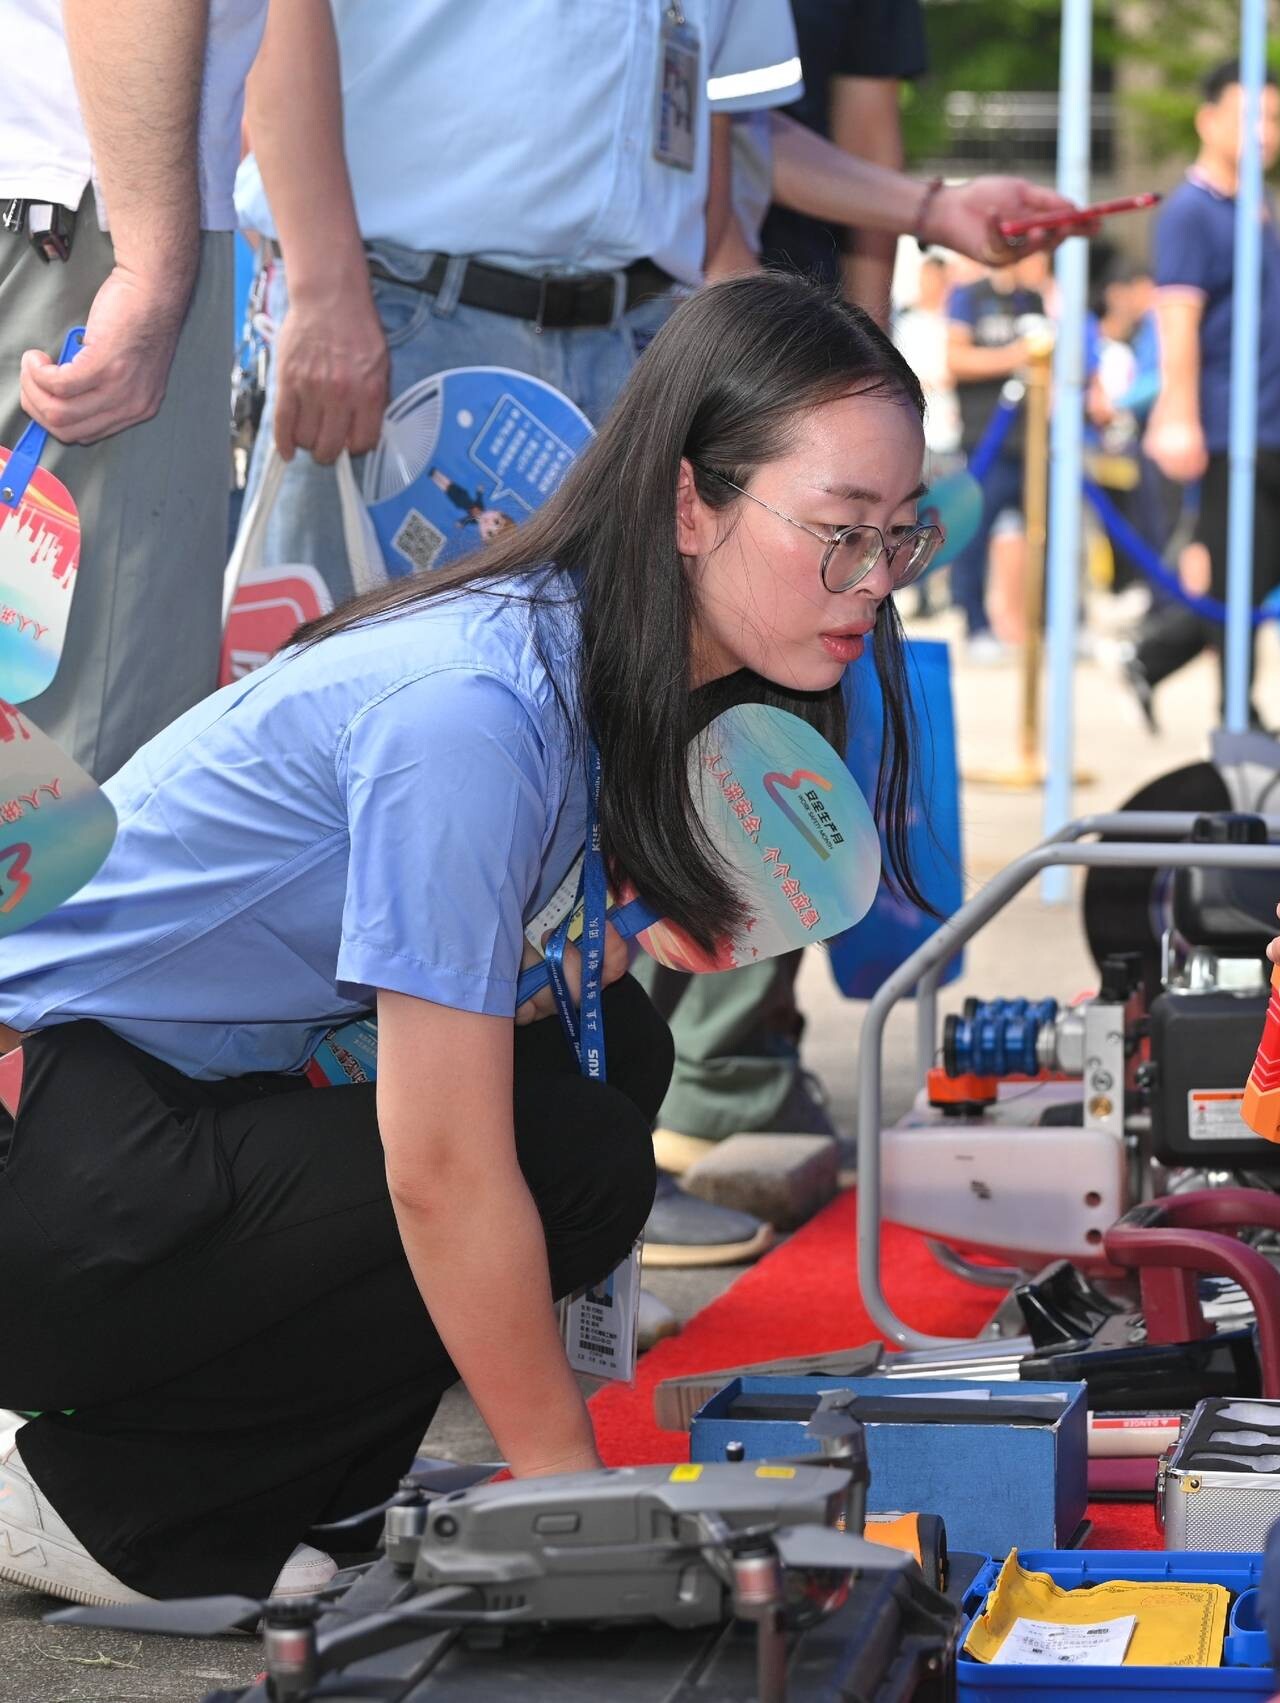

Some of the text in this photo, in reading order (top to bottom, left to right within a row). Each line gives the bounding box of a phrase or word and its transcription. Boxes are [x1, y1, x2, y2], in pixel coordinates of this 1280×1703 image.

[804, 790, 844, 844] 安全生产月
[588, 917, 599, 939] 团队
[586, 1008, 597, 1031] 正直
[588, 1048, 600, 1077] KUS
[1123, 1420, 1159, 1428] DANGER
